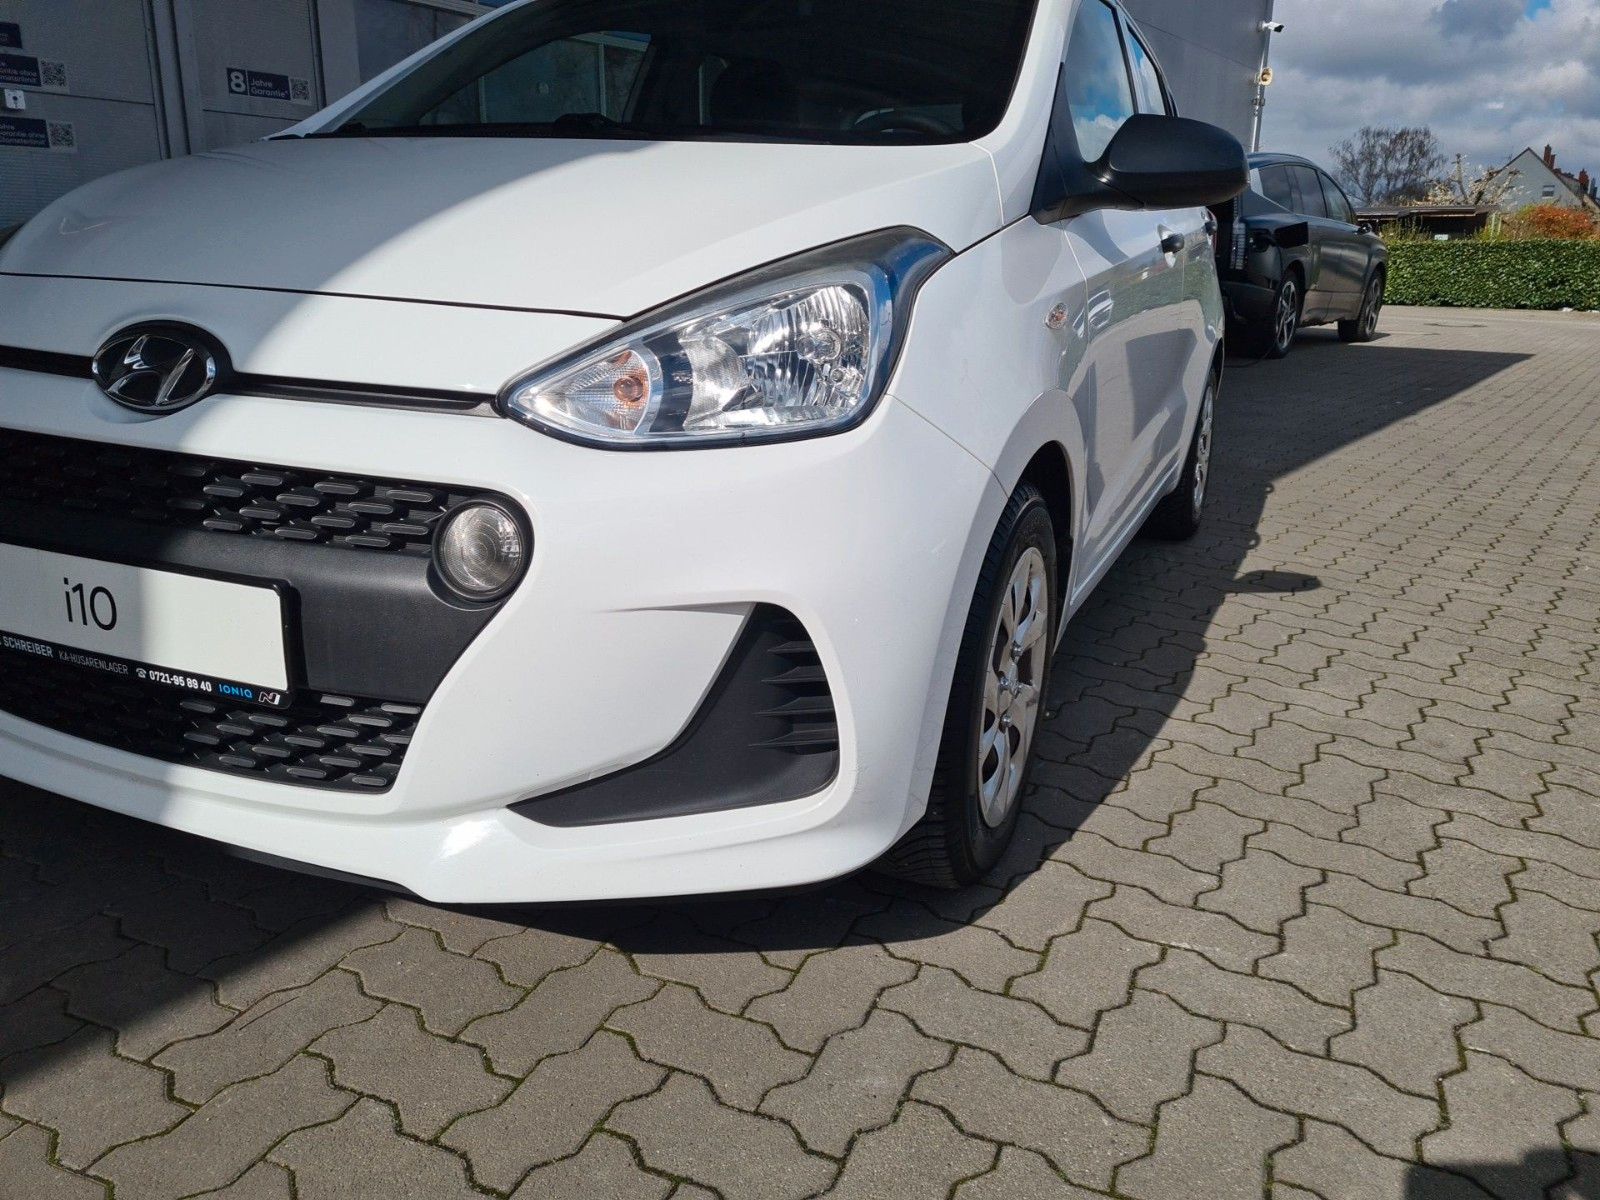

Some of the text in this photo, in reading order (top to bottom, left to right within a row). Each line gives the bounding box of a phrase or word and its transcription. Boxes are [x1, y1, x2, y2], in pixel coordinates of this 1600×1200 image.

[230, 71, 246, 92] 8
[251, 78, 273, 88] Jahre
[63, 577, 118, 631] i10
[2, 637, 53, 658] SCHREIBER
[58, 651, 129, 675] KA-HUSARENLAGER
[200, 681, 213, 692] 40
[218, 683, 253, 699] IONIQ
